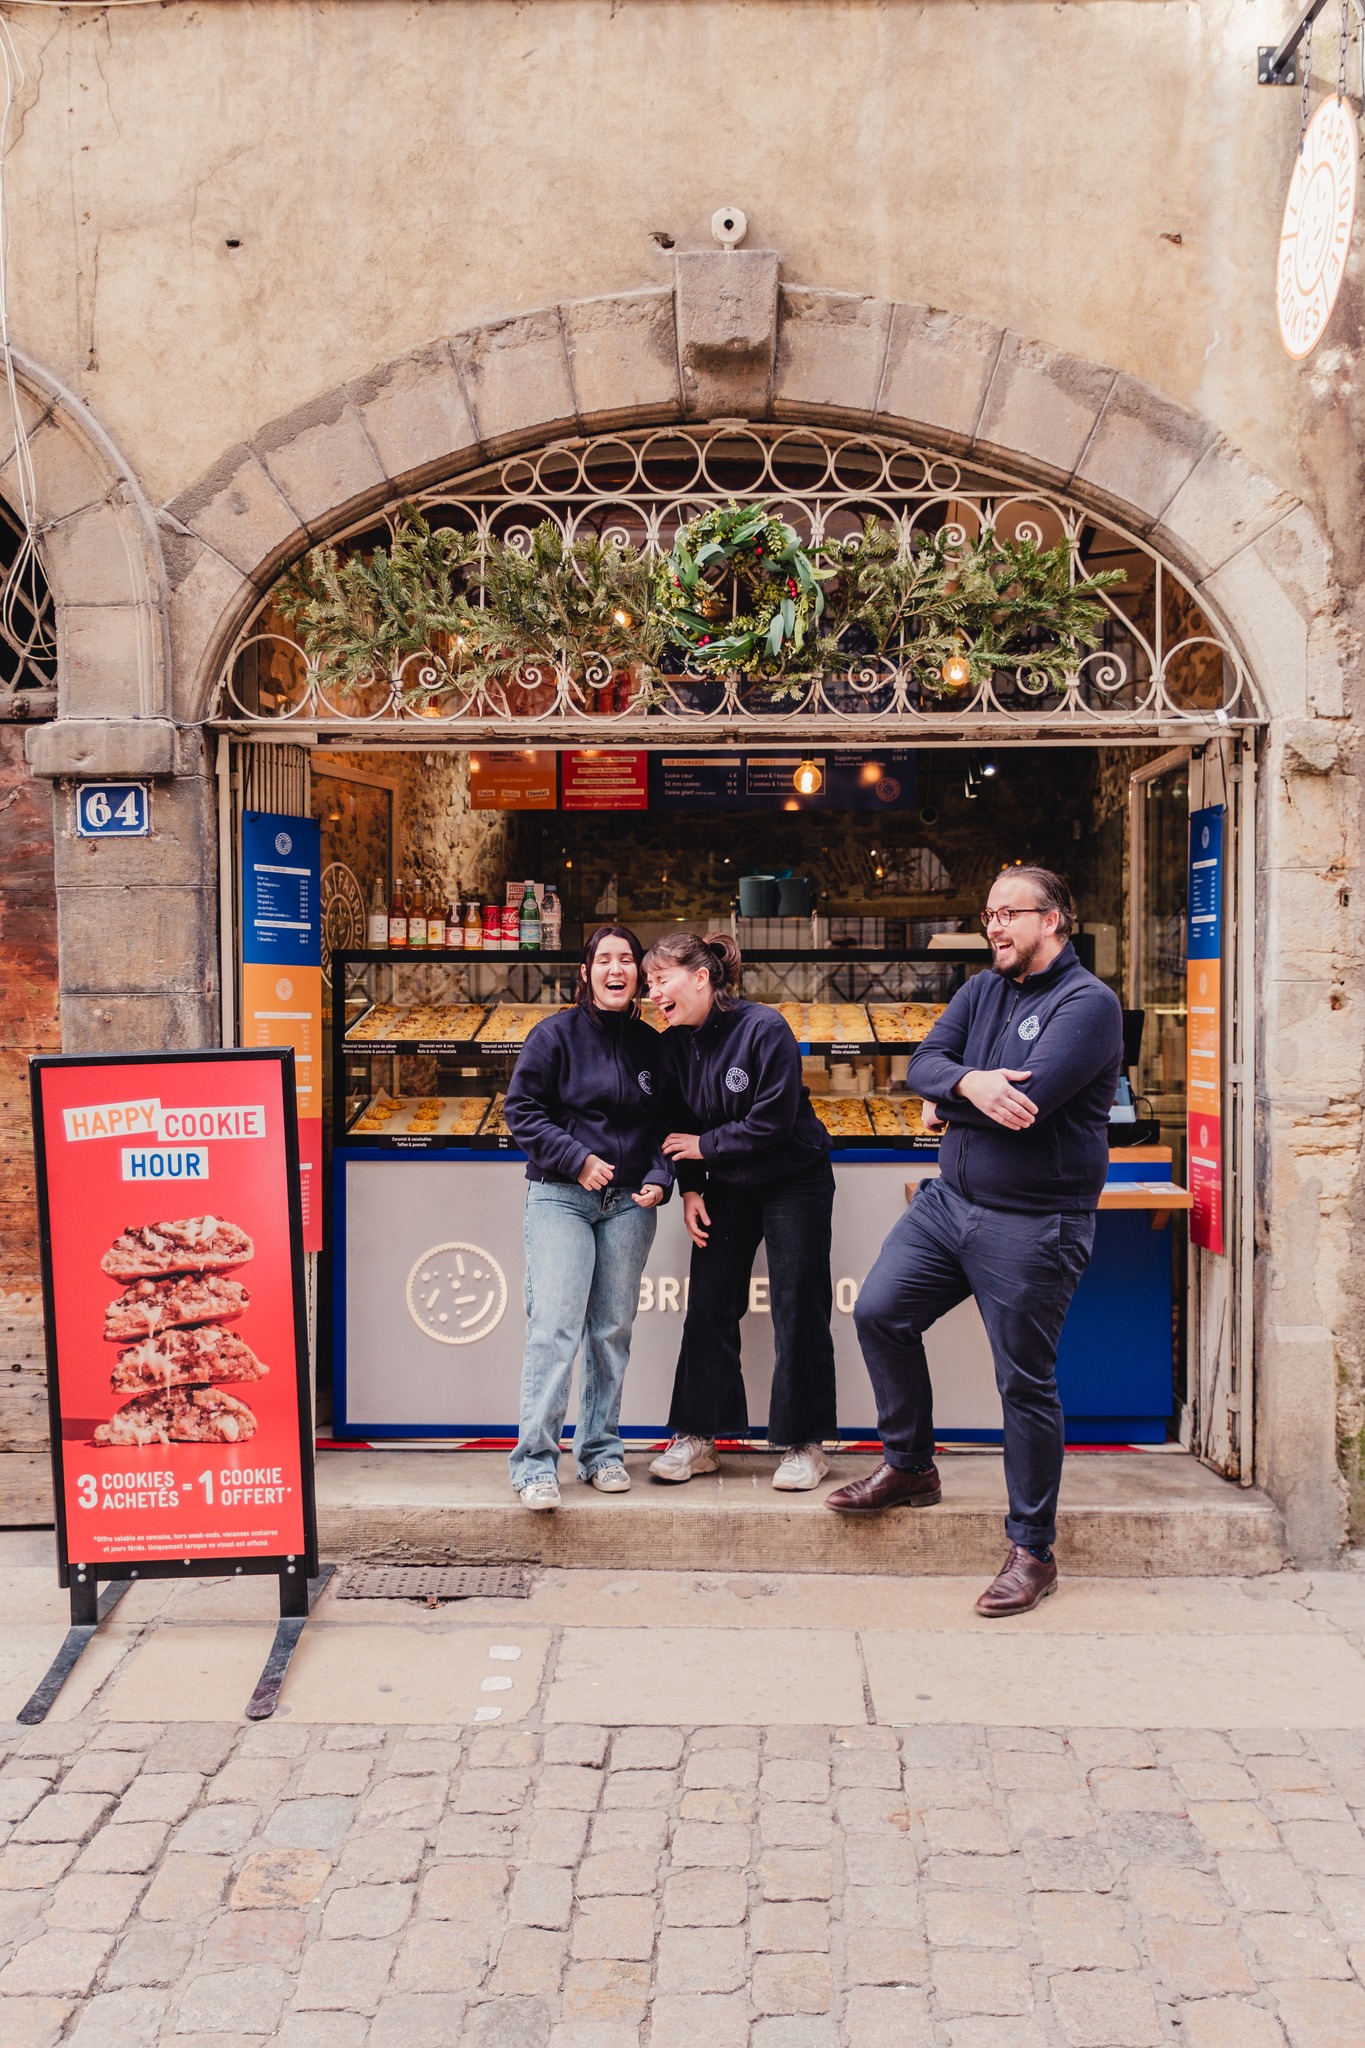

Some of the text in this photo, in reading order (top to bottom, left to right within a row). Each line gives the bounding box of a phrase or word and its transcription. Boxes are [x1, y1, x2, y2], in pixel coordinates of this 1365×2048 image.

[1289, 163, 1309, 217] LA
[1318, 111, 1351, 281] FABRIQUE
[1281, 253, 1320, 343] COOKIES
[86, 791, 139, 827] 64
[72, 1104, 258, 1138] HAPPY COOKIE
[131, 1153, 200, 1177] HOUR
[77, 1473, 98, 1509] 3
[102, 1471, 175, 1490] COOKIES
[198, 1470, 214, 1505] 1
[220, 1467, 283, 1486] COOKIE
[102, 1488, 179, 1510] ACHETÉS
